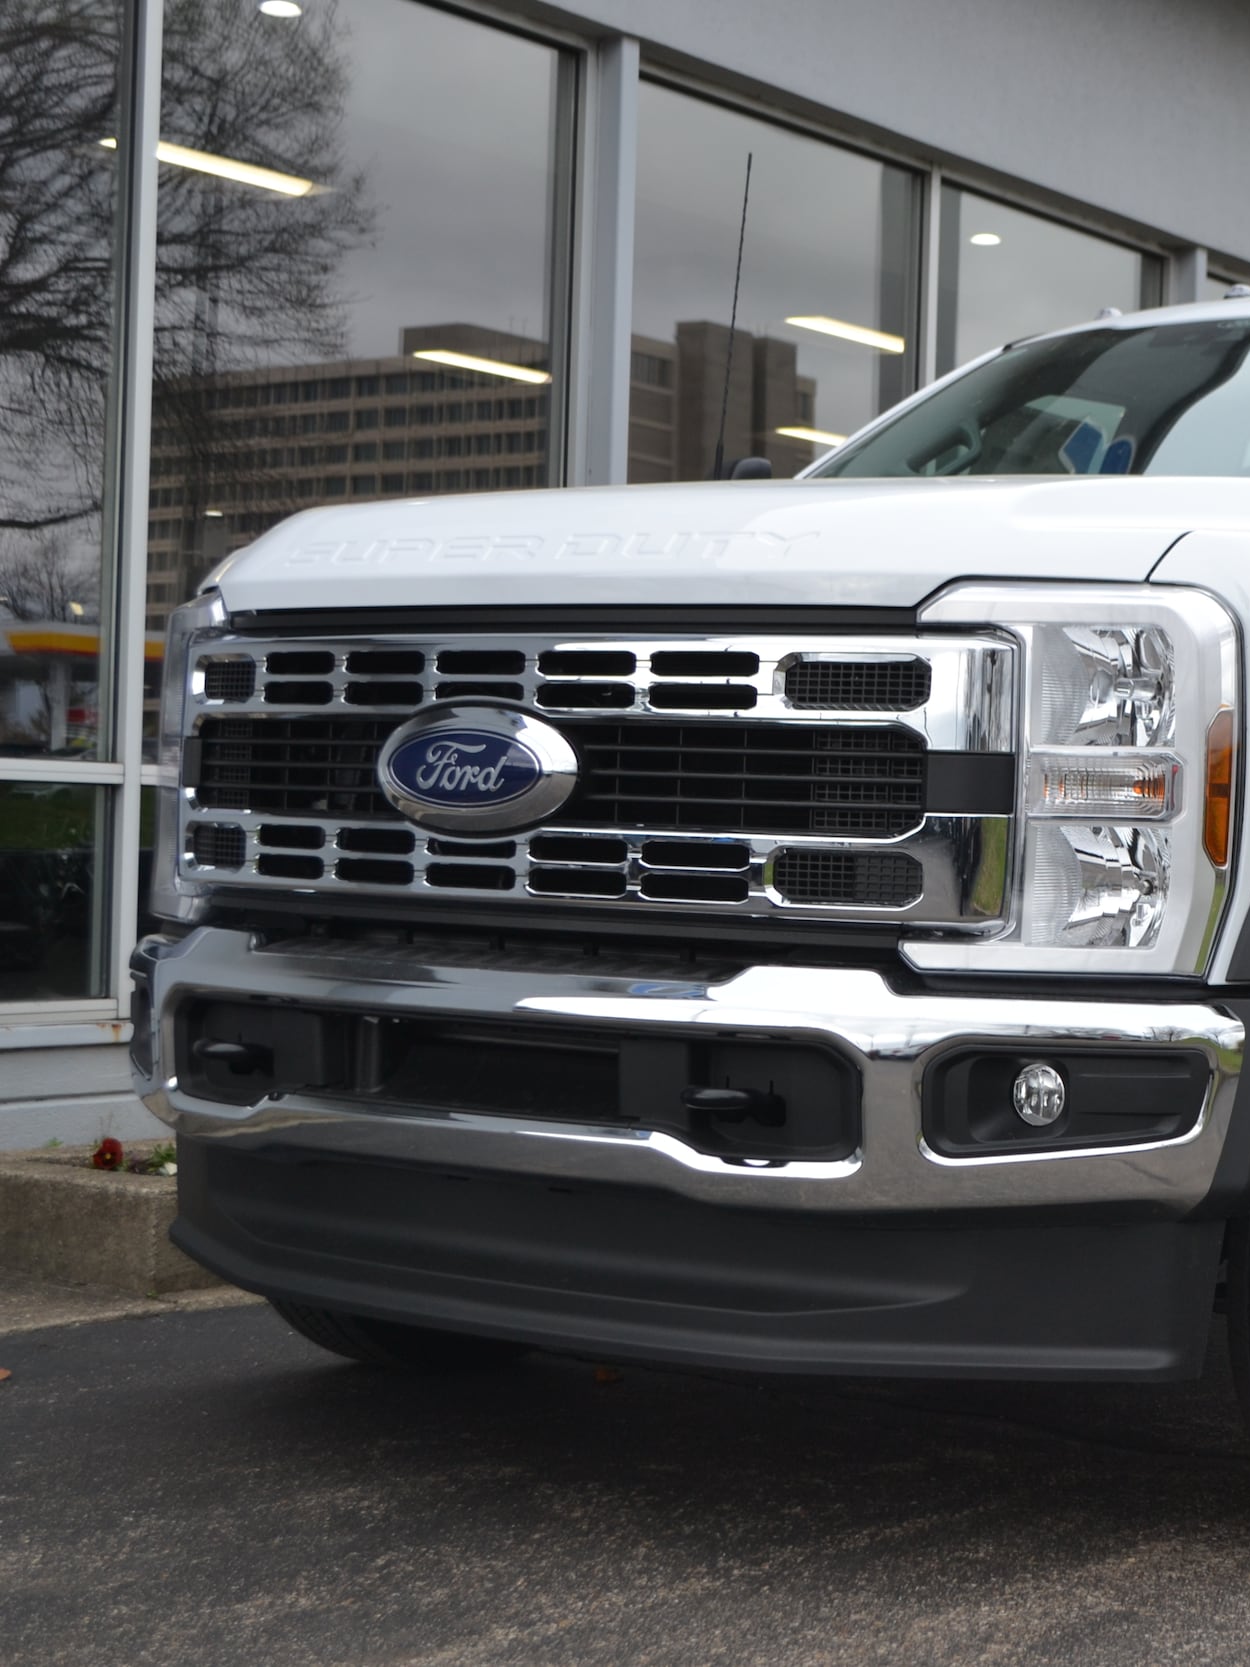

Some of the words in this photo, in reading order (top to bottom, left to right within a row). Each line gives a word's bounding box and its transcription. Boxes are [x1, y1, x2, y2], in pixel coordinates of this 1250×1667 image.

[285, 534, 546, 568] SUPER
[554, 530, 822, 562] DUTY
[416, 740, 505, 792] Ford
